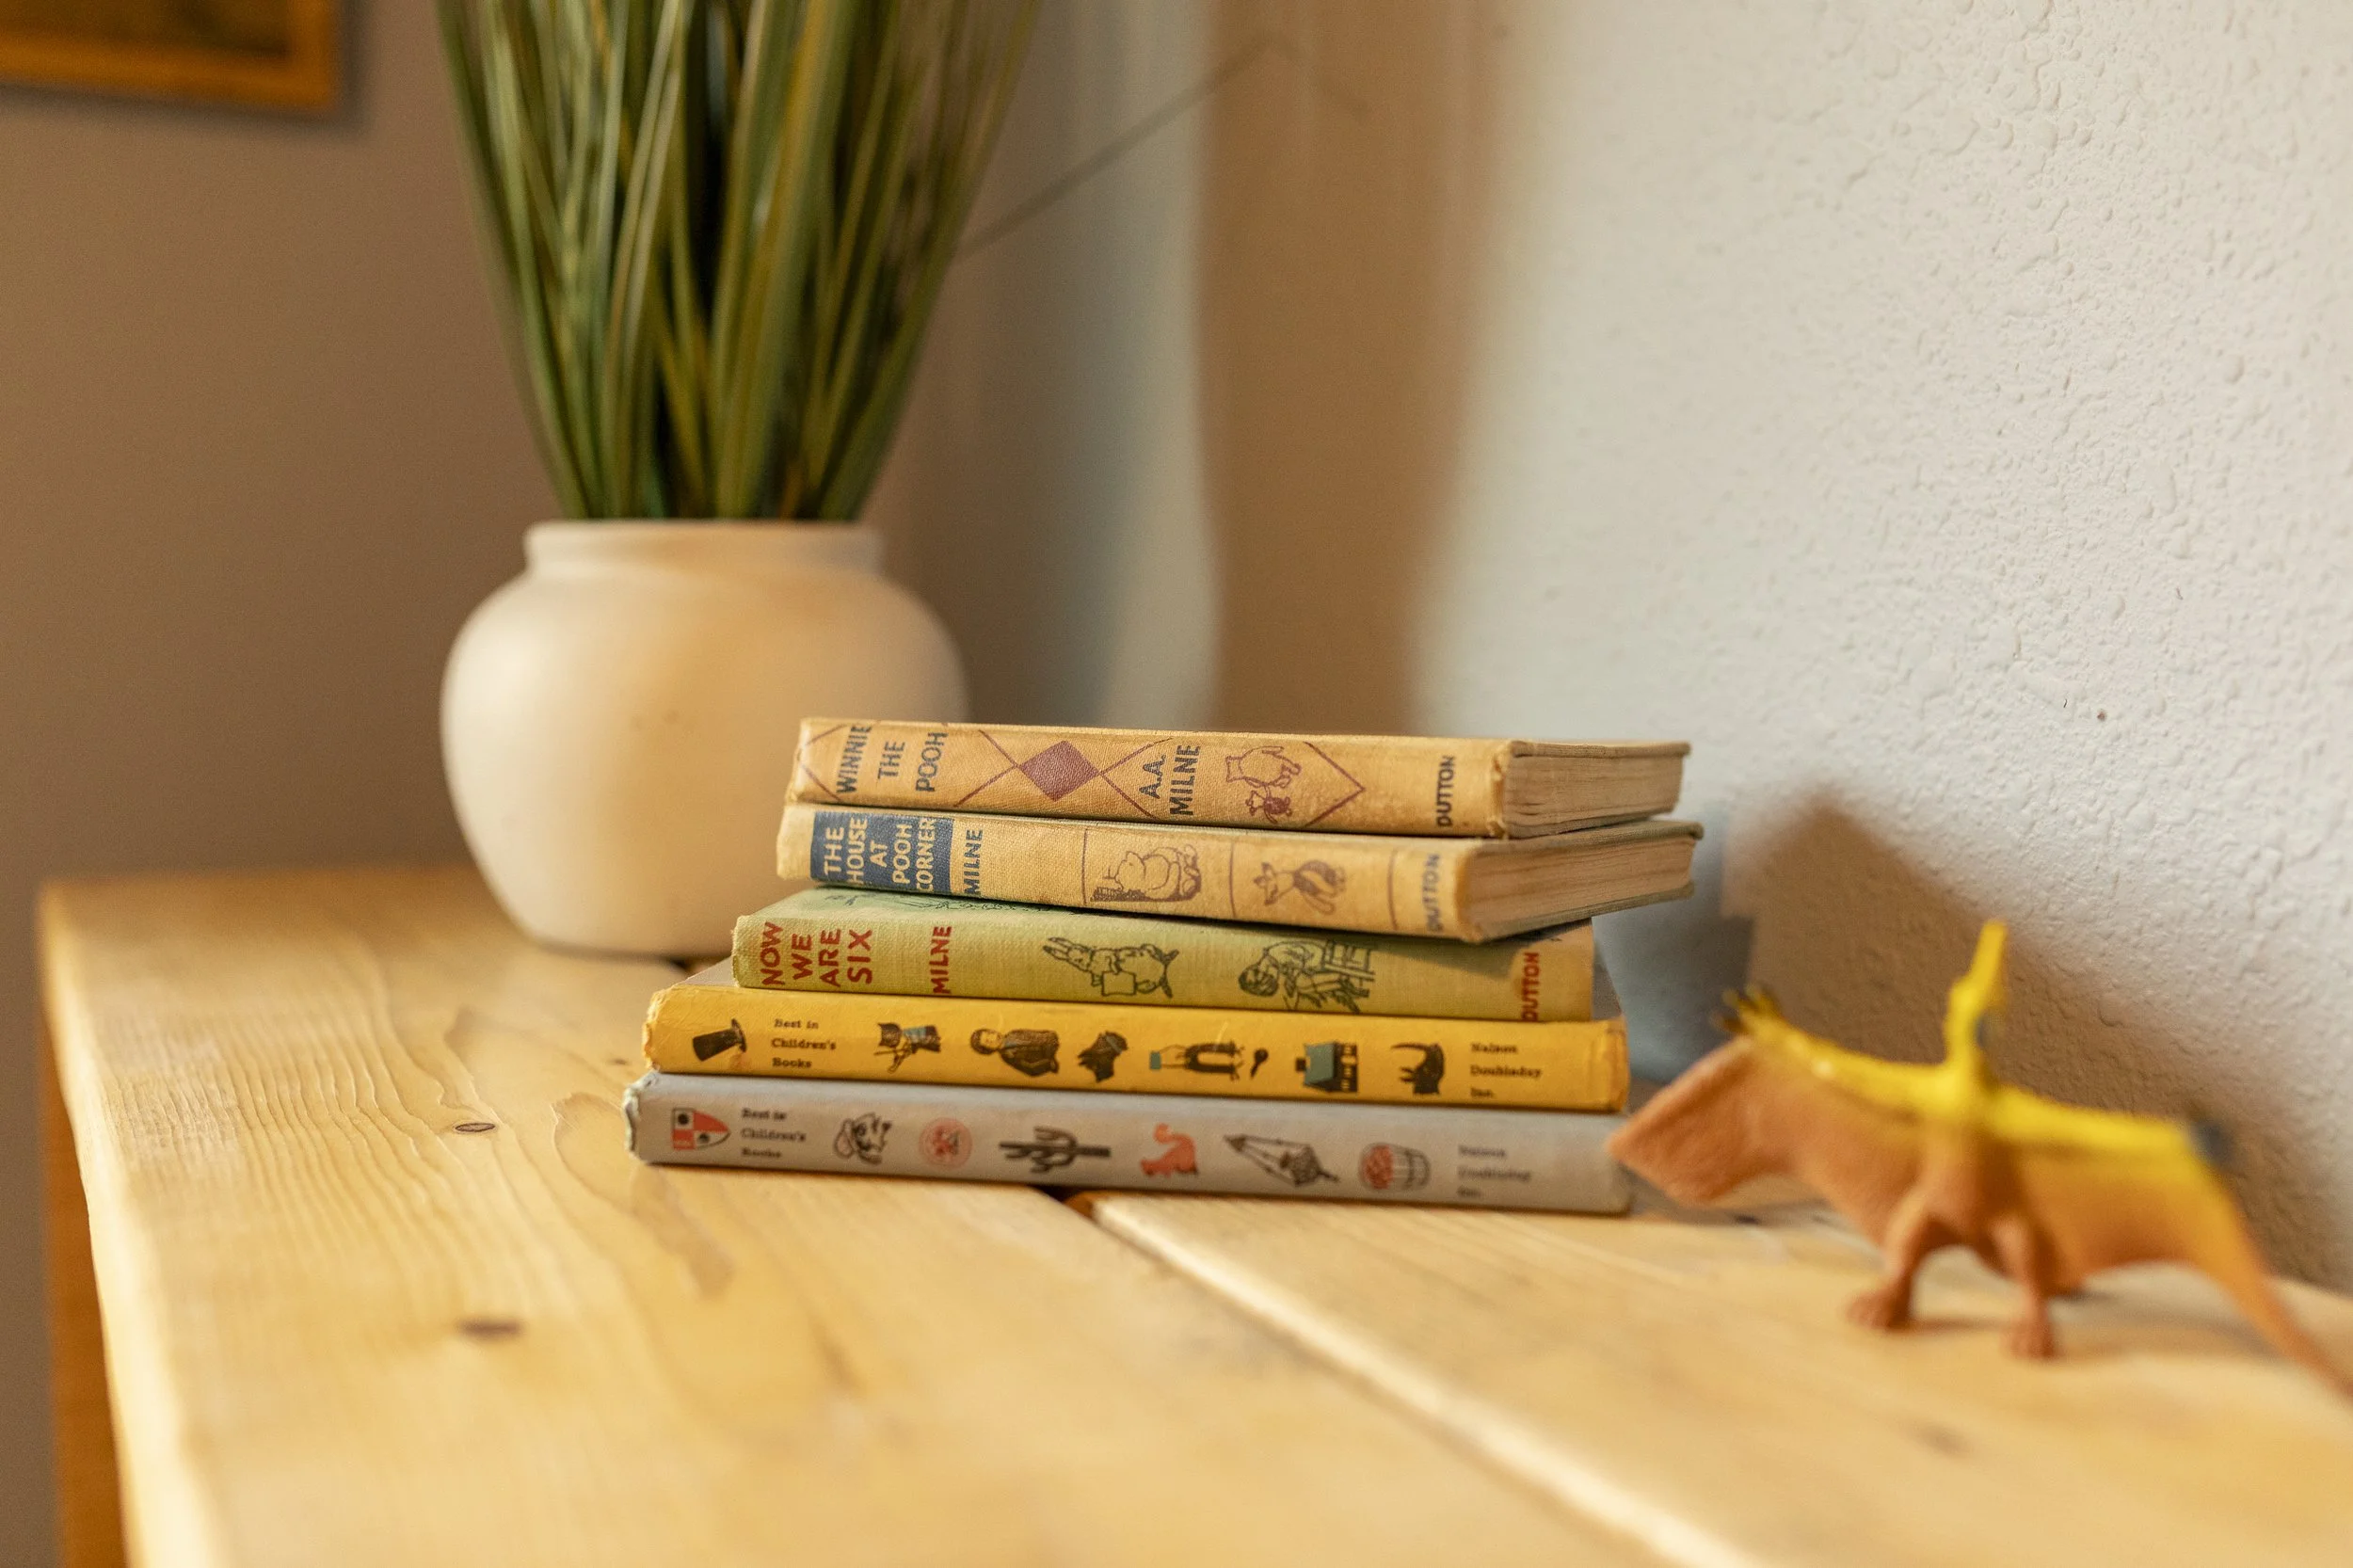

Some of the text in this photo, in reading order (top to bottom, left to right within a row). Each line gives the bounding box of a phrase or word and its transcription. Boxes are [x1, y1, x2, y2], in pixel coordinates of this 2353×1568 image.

[836, 726, 872, 793] WINNIE
[877, 742, 905, 779] THE
[915, 732, 949, 792] POOH
[1169, 745, 1201, 815] MILNE
[1436, 755, 1455, 828] DUTTON
[824, 826, 844, 875] THE
[847, 816, 868, 884] HOUSE
[870, 840, 888, 868] AT
[892, 824, 912, 884] POOH
[915, 817, 936, 892] CORNER
[964, 829, 983, 895] MILNE
[1423, 854, 1443, 933] DUTTON
[760, 921, 785, 985] NOW
[792, 933, 813, 980] WE
[818, 928, 841, 987] ARE
[847, 929, 872, 984] SIX
[929, 926, 952, 994] MILNE
[1521, 952, 1540, 1022] DUTTON
[771, 1038, 837, 1050] Children's
[775, 1018, 819, 1030] Best in
[772, 1057, 812, 1068] Books
